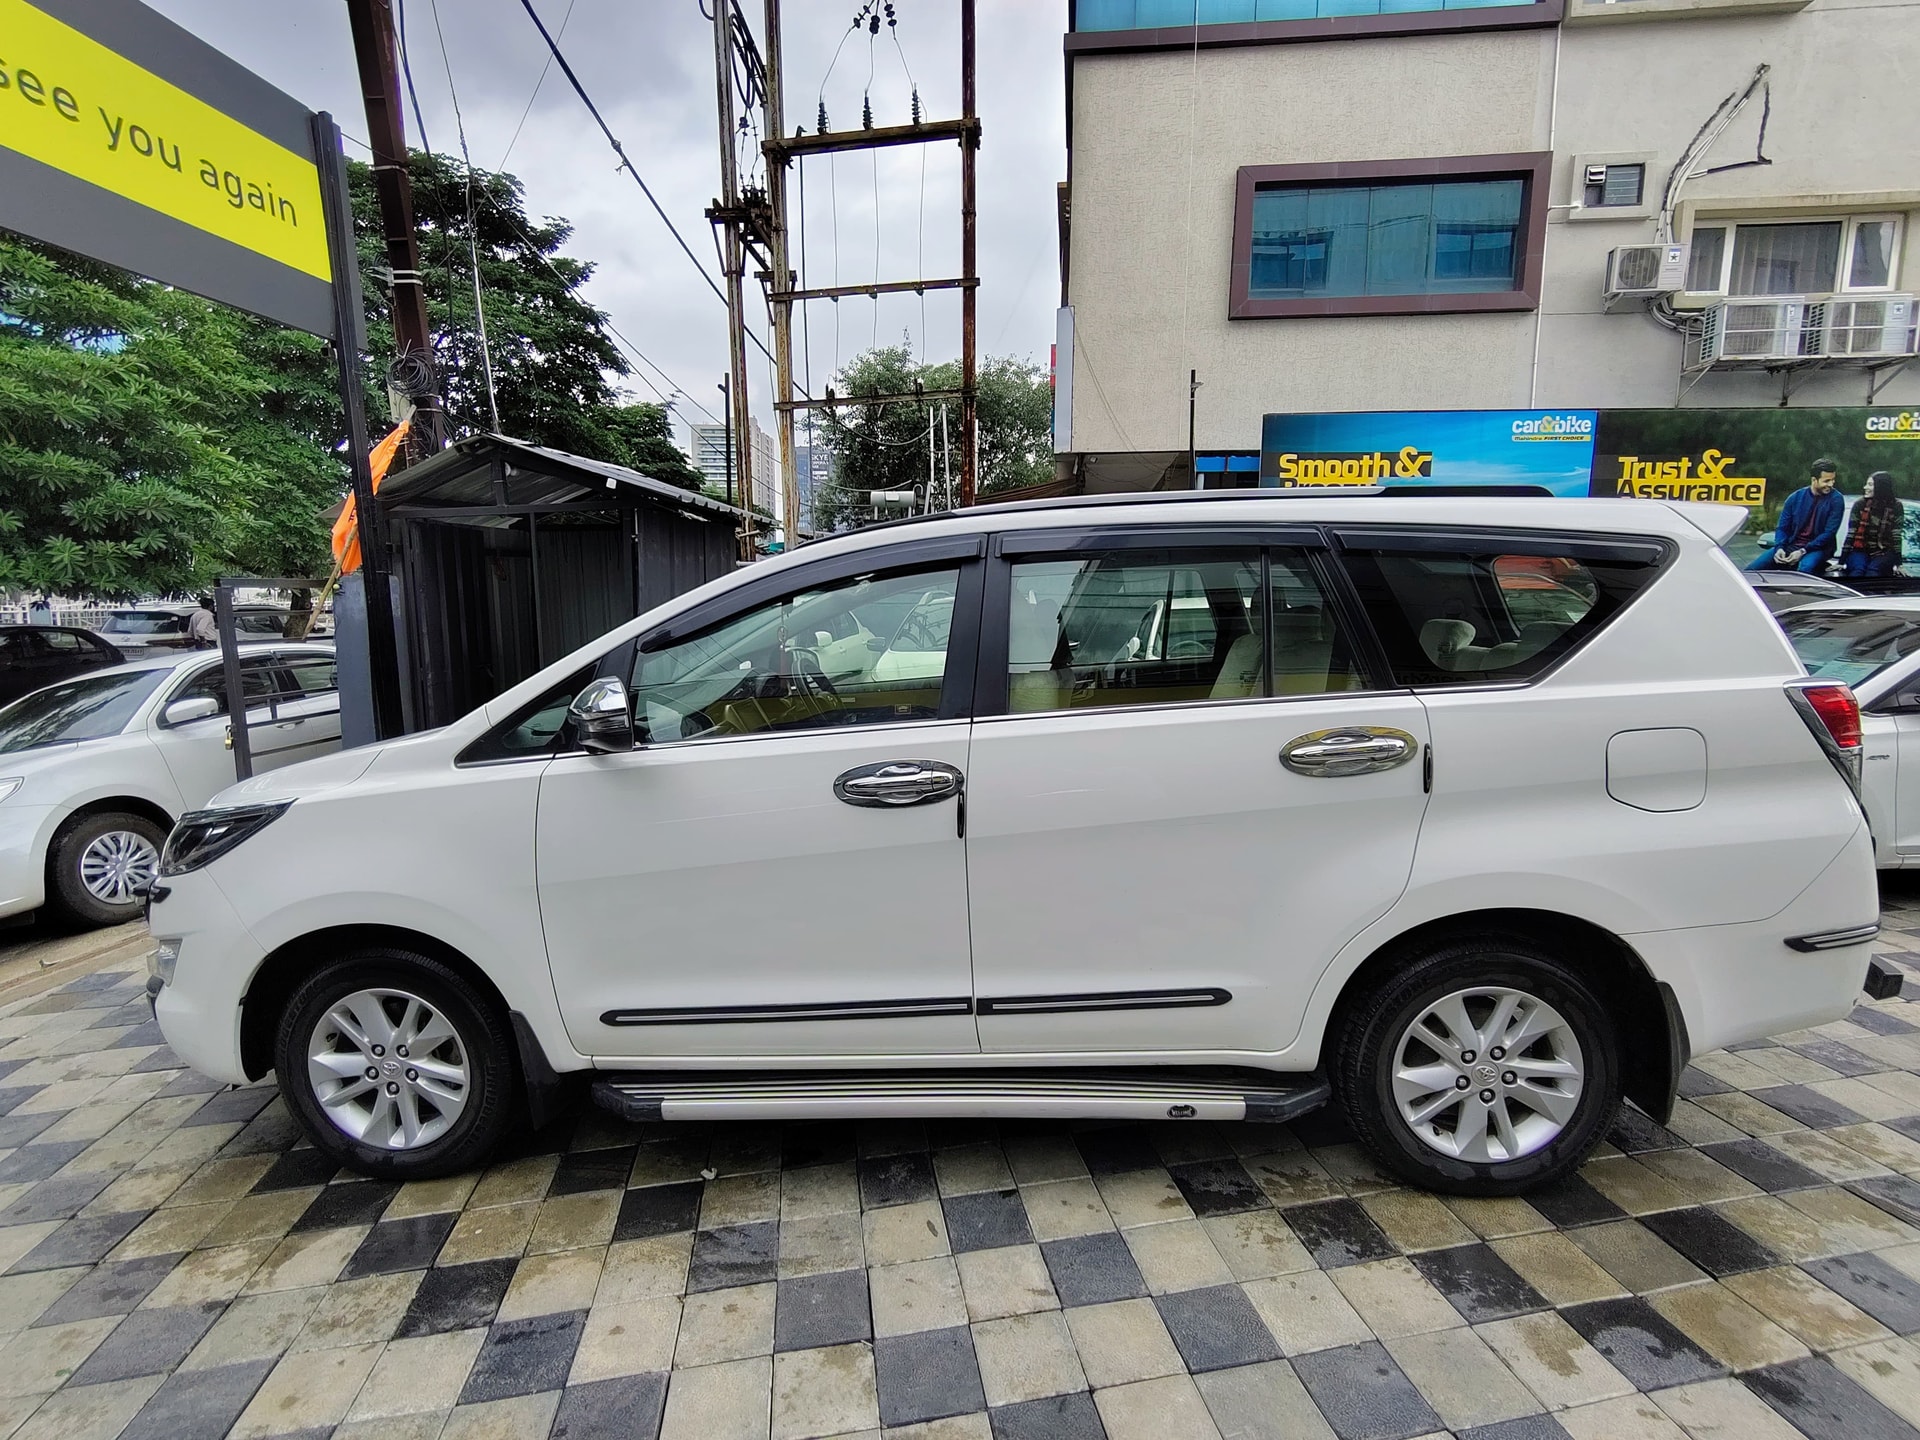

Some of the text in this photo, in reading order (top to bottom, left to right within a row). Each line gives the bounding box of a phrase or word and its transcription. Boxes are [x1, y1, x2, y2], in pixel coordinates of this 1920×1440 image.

[97, 106, 182, 174] you
[199, 158, 298, 227] again
[1511, 415, 1592, 433] car&bike
[1279, 445, 1433, 478] Smooth &
[1618, 448, 1736, 479] Trust &
[1617, 478, 1762, 502] Assurance
